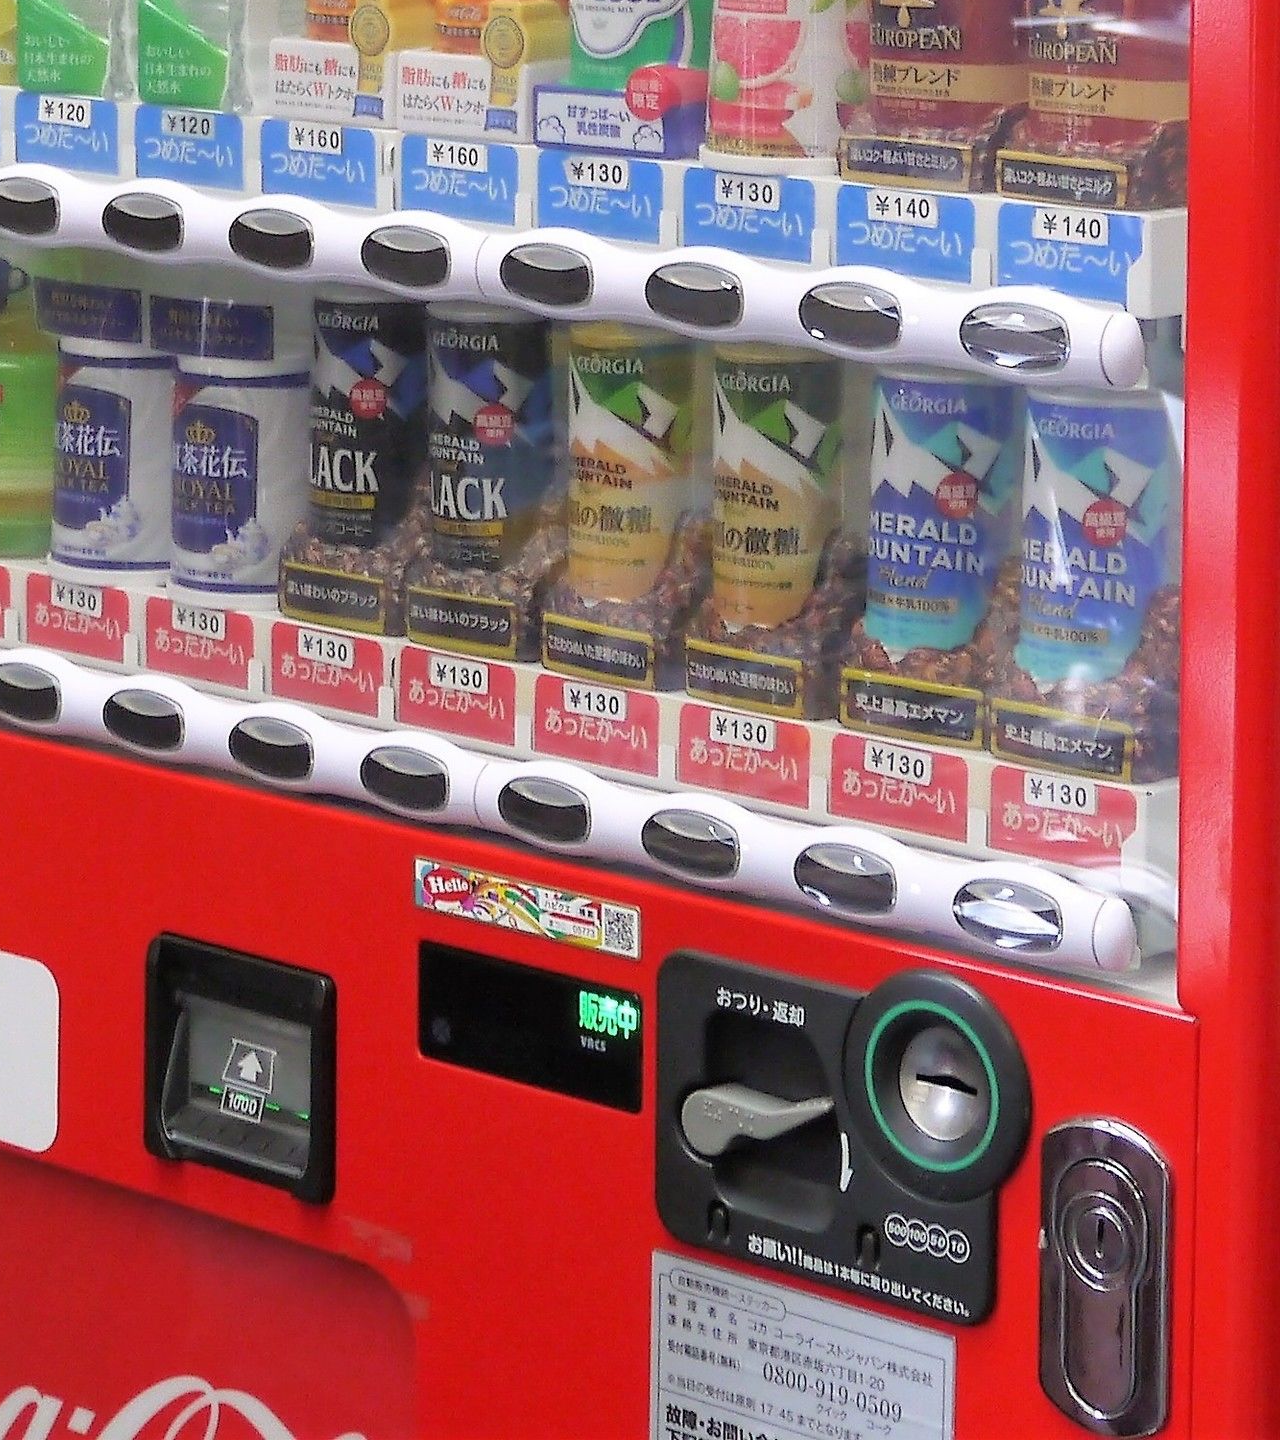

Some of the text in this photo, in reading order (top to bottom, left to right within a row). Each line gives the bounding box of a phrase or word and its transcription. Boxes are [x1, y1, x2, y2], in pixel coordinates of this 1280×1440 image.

[870, 23, 962, 53] EUROPEAN
[1028, 36, 1117, 66] EUROPEAN
[44, 100, 86, 122] ¥120
[166, 114, 211, 136] ¥120
[294, 127, 340, 150] ¥160
[433, 144, 479, 167] ¥160
[571, 162, 622, 185] ¥130
[720, 180, 774, 204] ¥130
[875, 196, 931, 219] ¥140
[1043, 214, 1102, 240] ¥140
[56, 422, 121, 457] 茶花伝
[174, 443, 248, 479] 茶花伝
[55, 586, 97, 611] ¥130
[177, 608, 220, 634] ¥130
[302, 637, 348, 662] ¥130
[436, 664, 483, 689] ¥130
[569, 689, 620, 714] ¥130
[855, 691, 966, 724] 史上最高エメマン
[716, 718, 768, 745] ¥130
[1004, 721, 1114, 759] 史上最高エメマン
[871, 752, 925, 779] ¥130
[1029, 781, 1087, 808] ¥130
[428, 875, 469, 894] Hello
[579, 990, 637, 1040] 販売中
[715, 985, 806, 1028] おつり・返却
[227, 1090, 258, 1116] 1000
[909, 1226, 926, 1244] 100
[930, 1231, 946, 1249] 50
[951, 1238, 965, 1255] 10
[762, 1361, 903, 1424] 0800-919-0509
